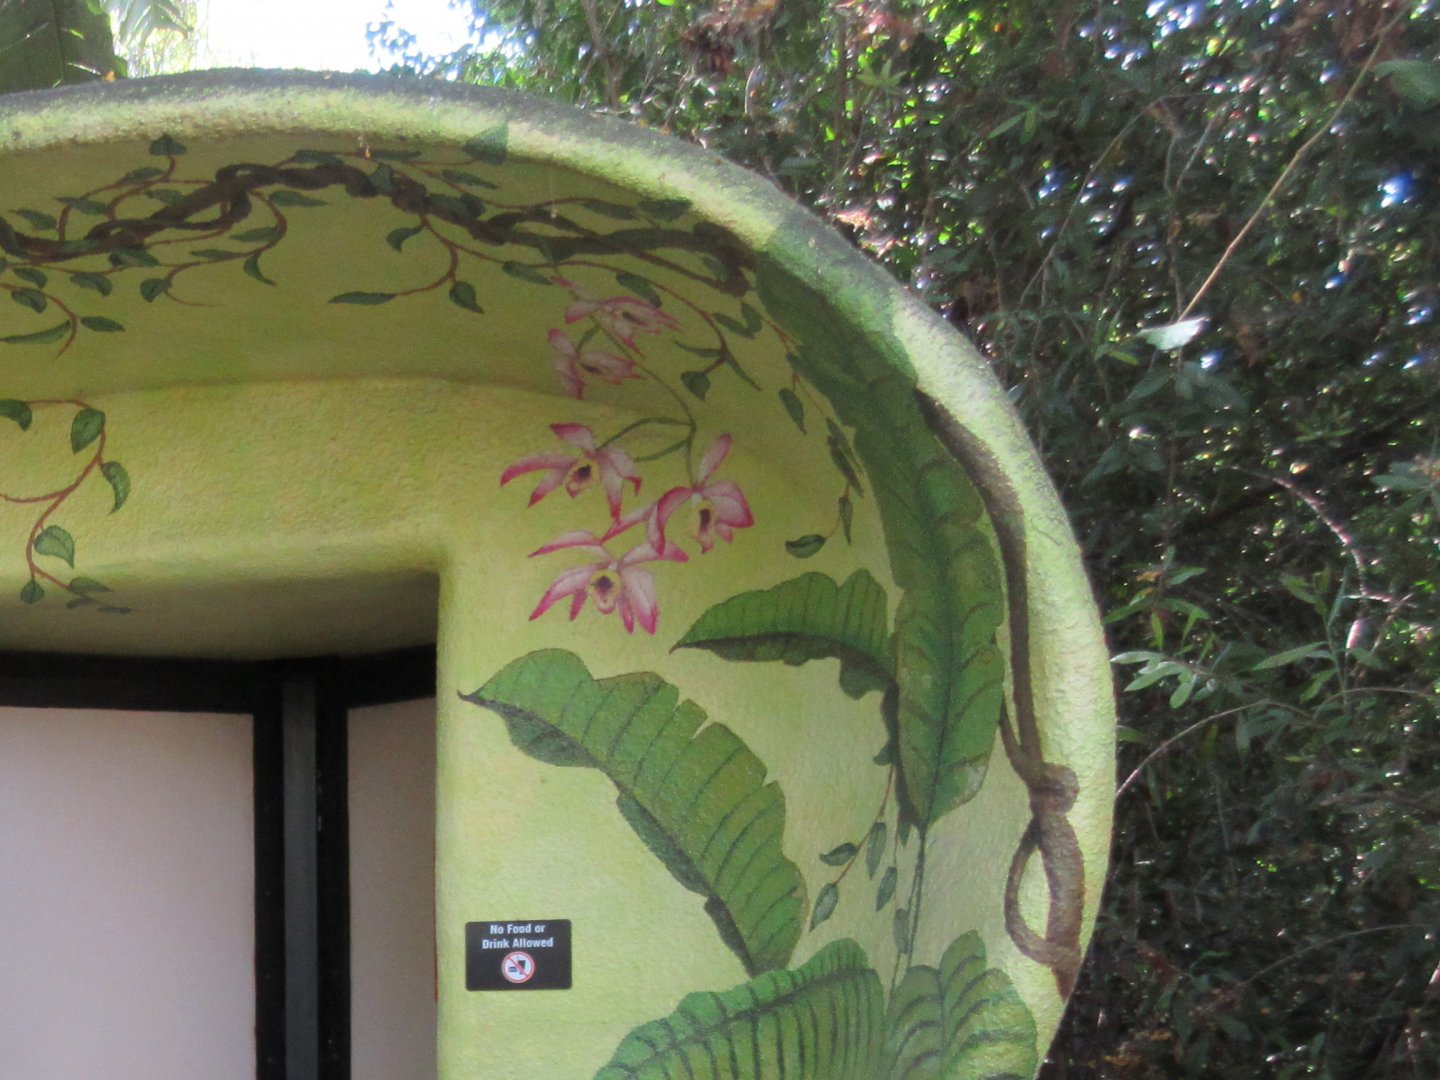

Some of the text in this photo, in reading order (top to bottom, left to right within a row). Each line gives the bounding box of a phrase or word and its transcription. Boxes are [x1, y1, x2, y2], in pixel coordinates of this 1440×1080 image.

[490, 923, 546, 935] No Food or
[482, 937, 554, 949] Drink Allowed
